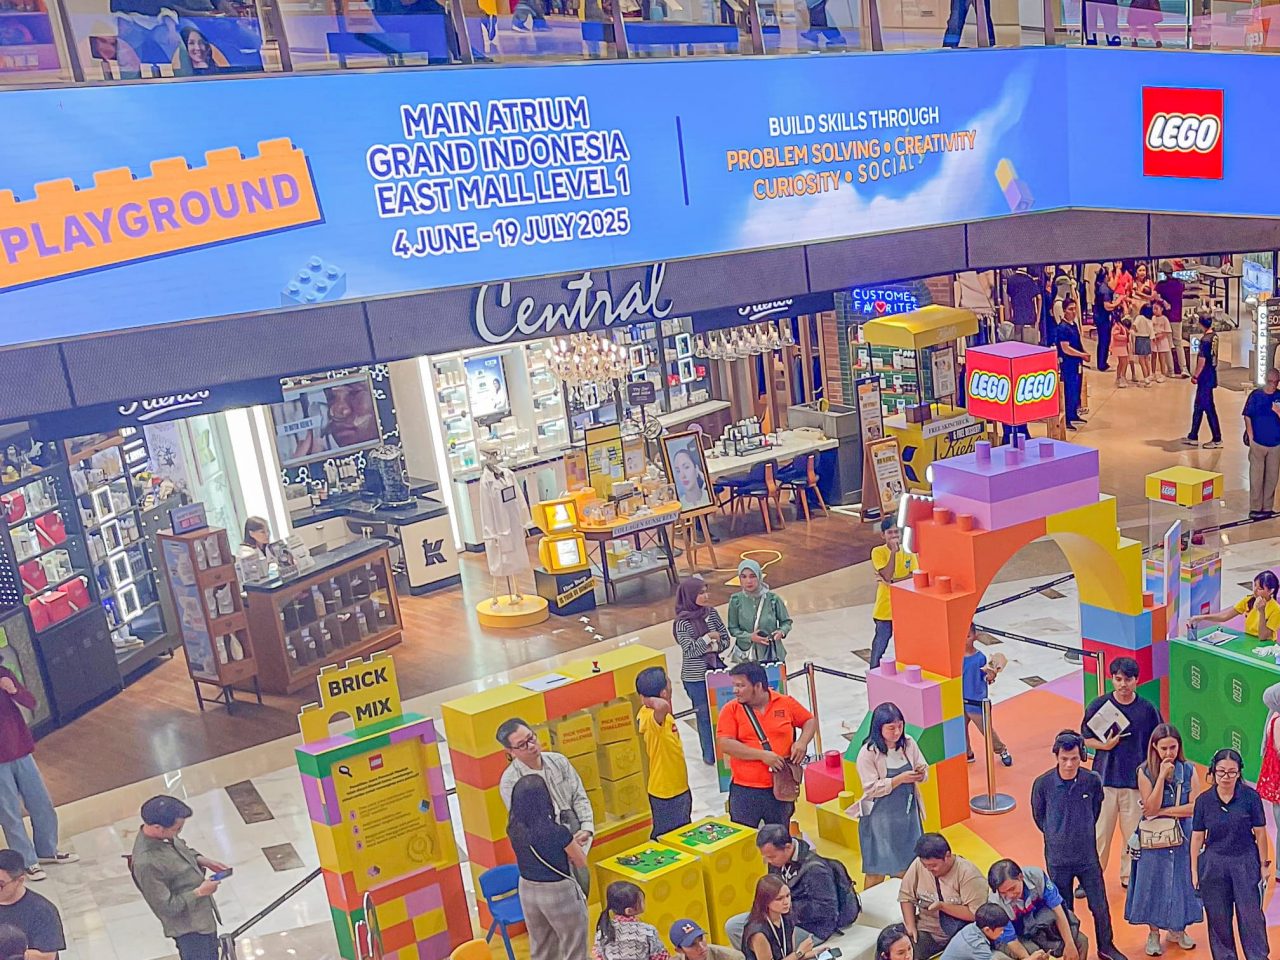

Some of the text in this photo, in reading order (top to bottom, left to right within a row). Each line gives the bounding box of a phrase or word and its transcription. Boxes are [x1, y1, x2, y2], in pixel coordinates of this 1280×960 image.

[402, 98, 589, 138] MAIN ATRIUM
[768, 106, 940, 137] BUILD SKILLS THROUGH
[1148, 114, 1220, 152] LEGO
[369, 131, 629, 177] GRAND INDONESIA
[726, 145, 809, 171] PROBLEM
[811, 138, 881, 164] SOLVING
[894, 129, 977, 156] CREATIVITY
[376, 166, 629, 215] EAST MALL LEVEL 1
[753, 156, 915, 200] CURIOSITY SOCIAL
[0, 173, 301, 265] PLAYGROUND
[394, 231, 411, 256] 4
[414, 224, 478, 255] JUNE
[495, 219, 519, 246] 19
[523, 214, 574, 243] JULY
[577, 208, 630, 237] 2025
[475, 261, 674, 344] Central
[969, 370, 1011, 404] LEGO
[1014, 369, 1058, 405] LEGO
[328, 666, 388, 697] BRICK
[355, 697, 392, 721] MIX
